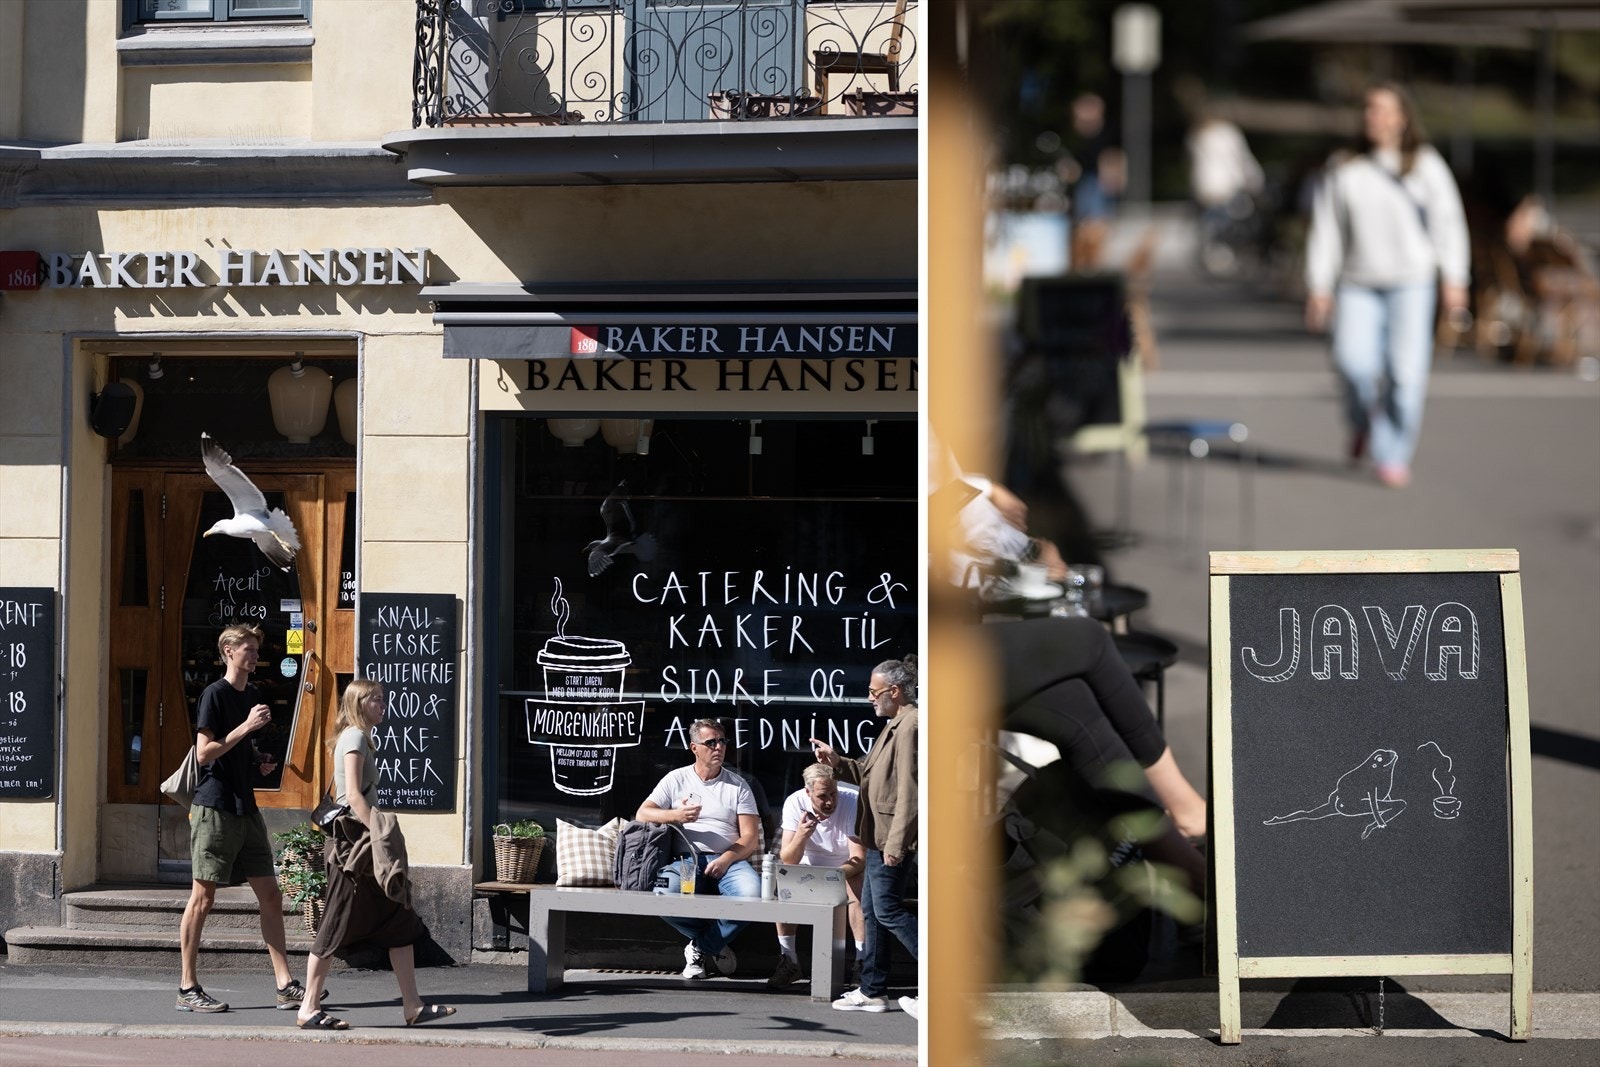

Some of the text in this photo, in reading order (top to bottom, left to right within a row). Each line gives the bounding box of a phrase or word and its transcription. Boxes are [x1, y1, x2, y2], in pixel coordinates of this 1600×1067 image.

[8, 247, 430, 288] 1861 BAKER HANSEN
[605, 326, 724, 353] BAKER
[737, 326, 897, 353] HANSEN
[524, 358, 697, 391] BAKER
[341, 571, 352, 580] TO
[342, 580, 356, 590] GOO
[632, 565, 908, 609] CATERING &
[208, 598, 237, 627] for
[240, 602, 267, 620] deg
[372, 633, 441, 656] FERSKE
[669, 611, 892, 654] KAKER TIL
[1241, 602, 1480, 683] JAVA
[366, 657, 455, 684] GLUTENFRIE
[565, 675, 603, 686] START DAGEN
[660, 665, 846, 707] STORE OG
[387, 686, 447, 720] RÖD &
[663, 712, 891, 754] AEDNING
[555, 748, 576, 757] MELLOM
[377, 797, 389, 805] eri
